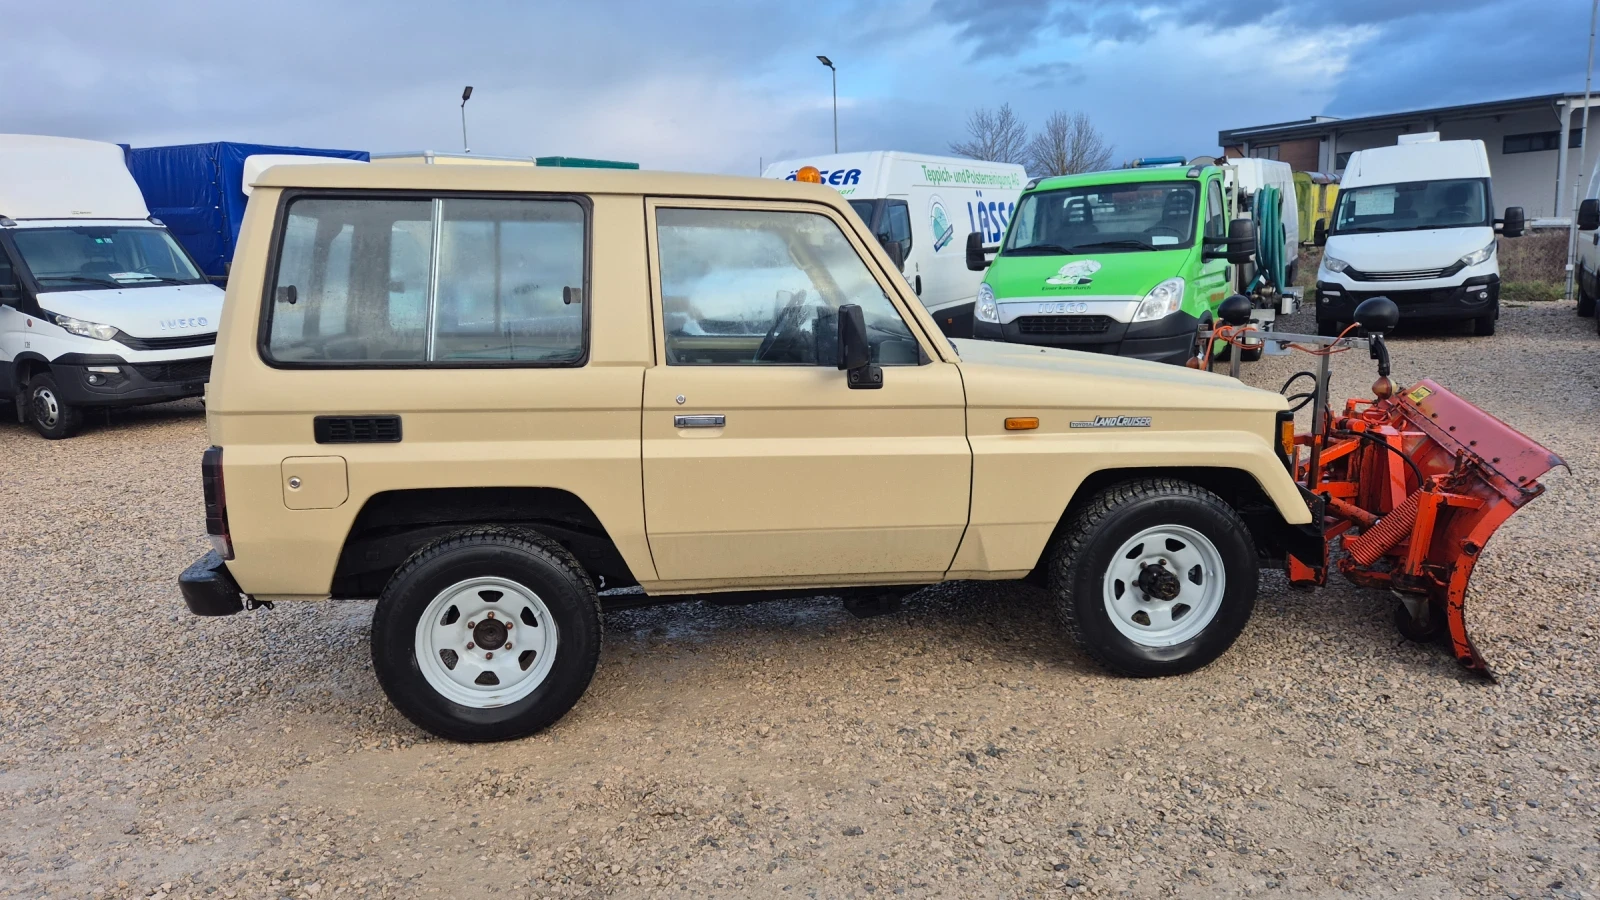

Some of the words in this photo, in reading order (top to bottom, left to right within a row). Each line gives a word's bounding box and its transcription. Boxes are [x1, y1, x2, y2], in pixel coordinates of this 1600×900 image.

[921, 165, 953, 186] Teppich-
[953, 170, 966, 184] und
[1038, 303, 1088, 314] IVECO
[159, 316, 208, 330] IVECO
